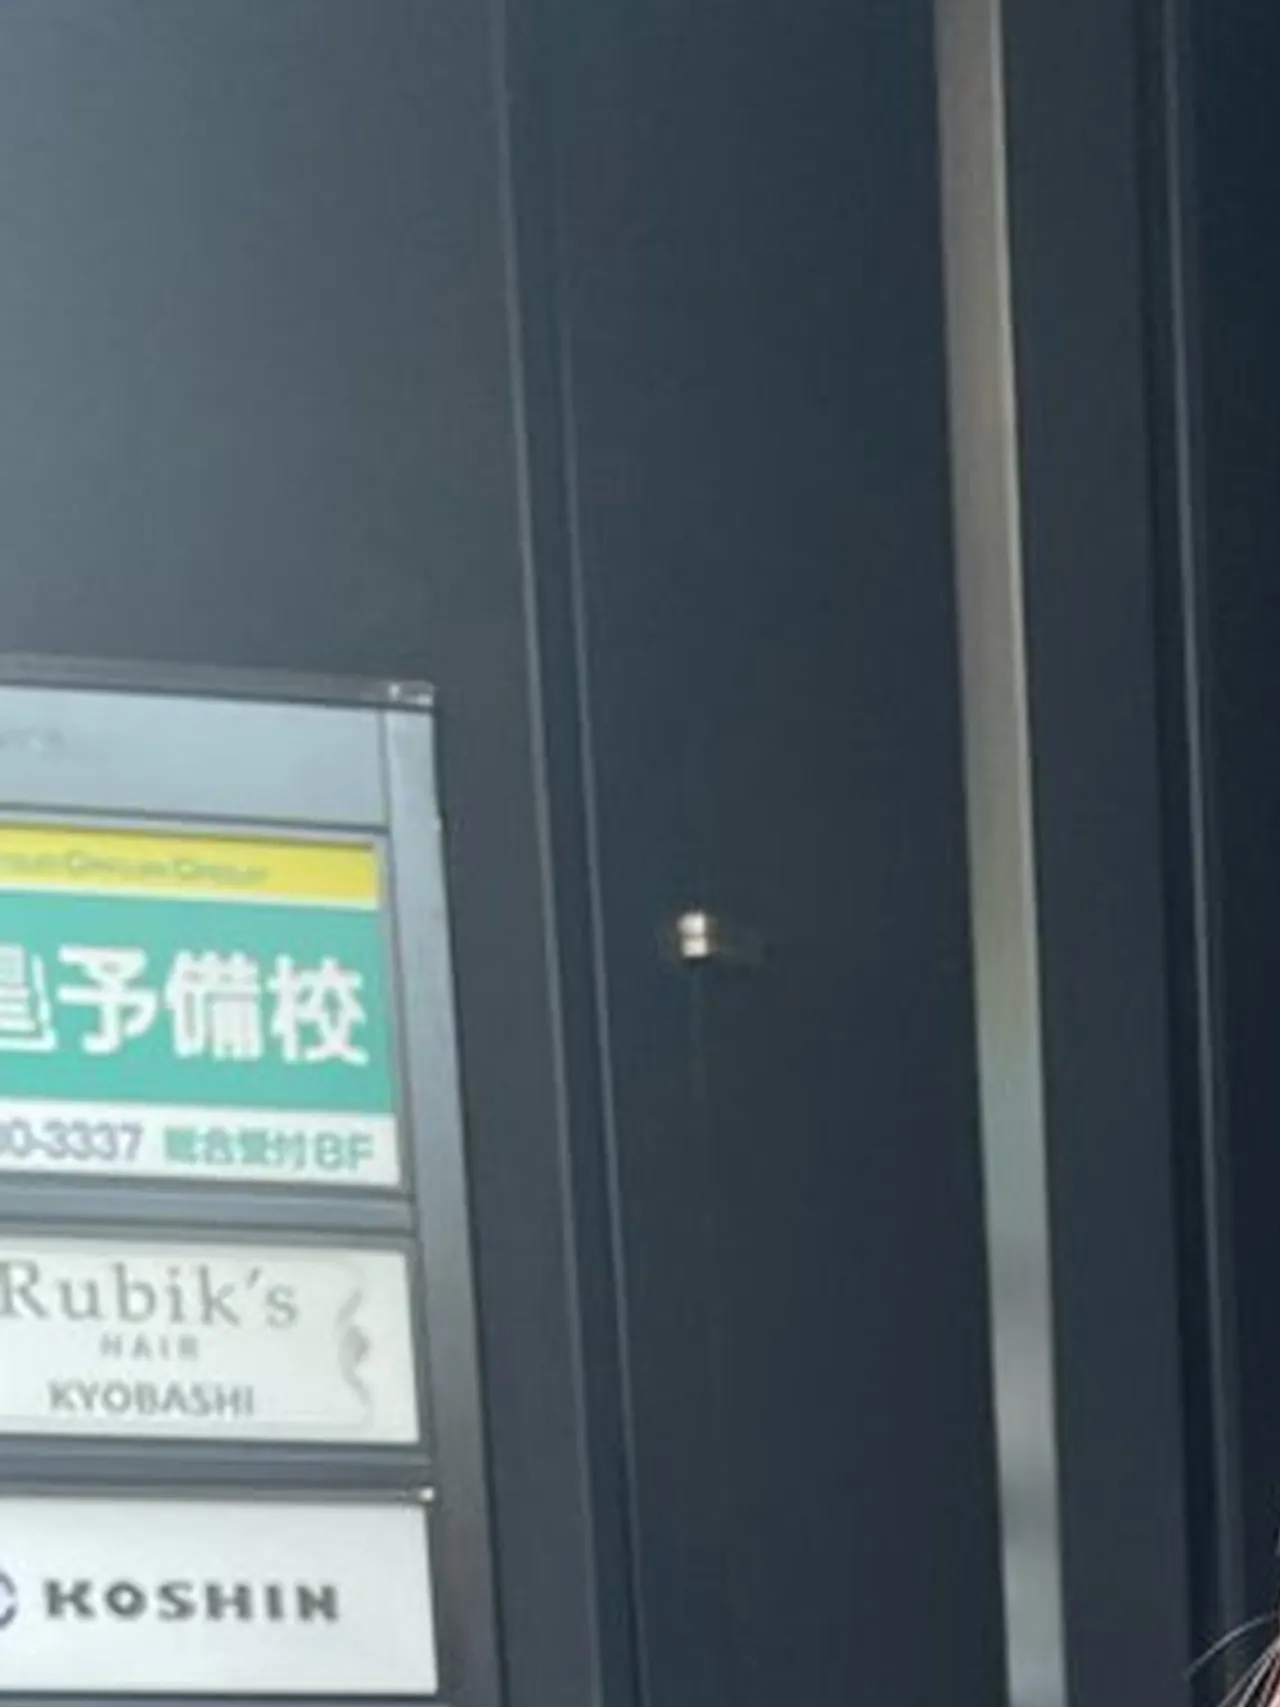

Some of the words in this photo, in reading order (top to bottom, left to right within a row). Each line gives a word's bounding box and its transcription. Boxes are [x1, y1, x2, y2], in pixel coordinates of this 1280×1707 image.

[0, 1260, 298, 1328] Rubik's
[100, 1333, 199, 1361] HAIR
[47, 1380, 255, 1418] KYOBASHI
[44, 1579, 339, 1623] KOSHIN
